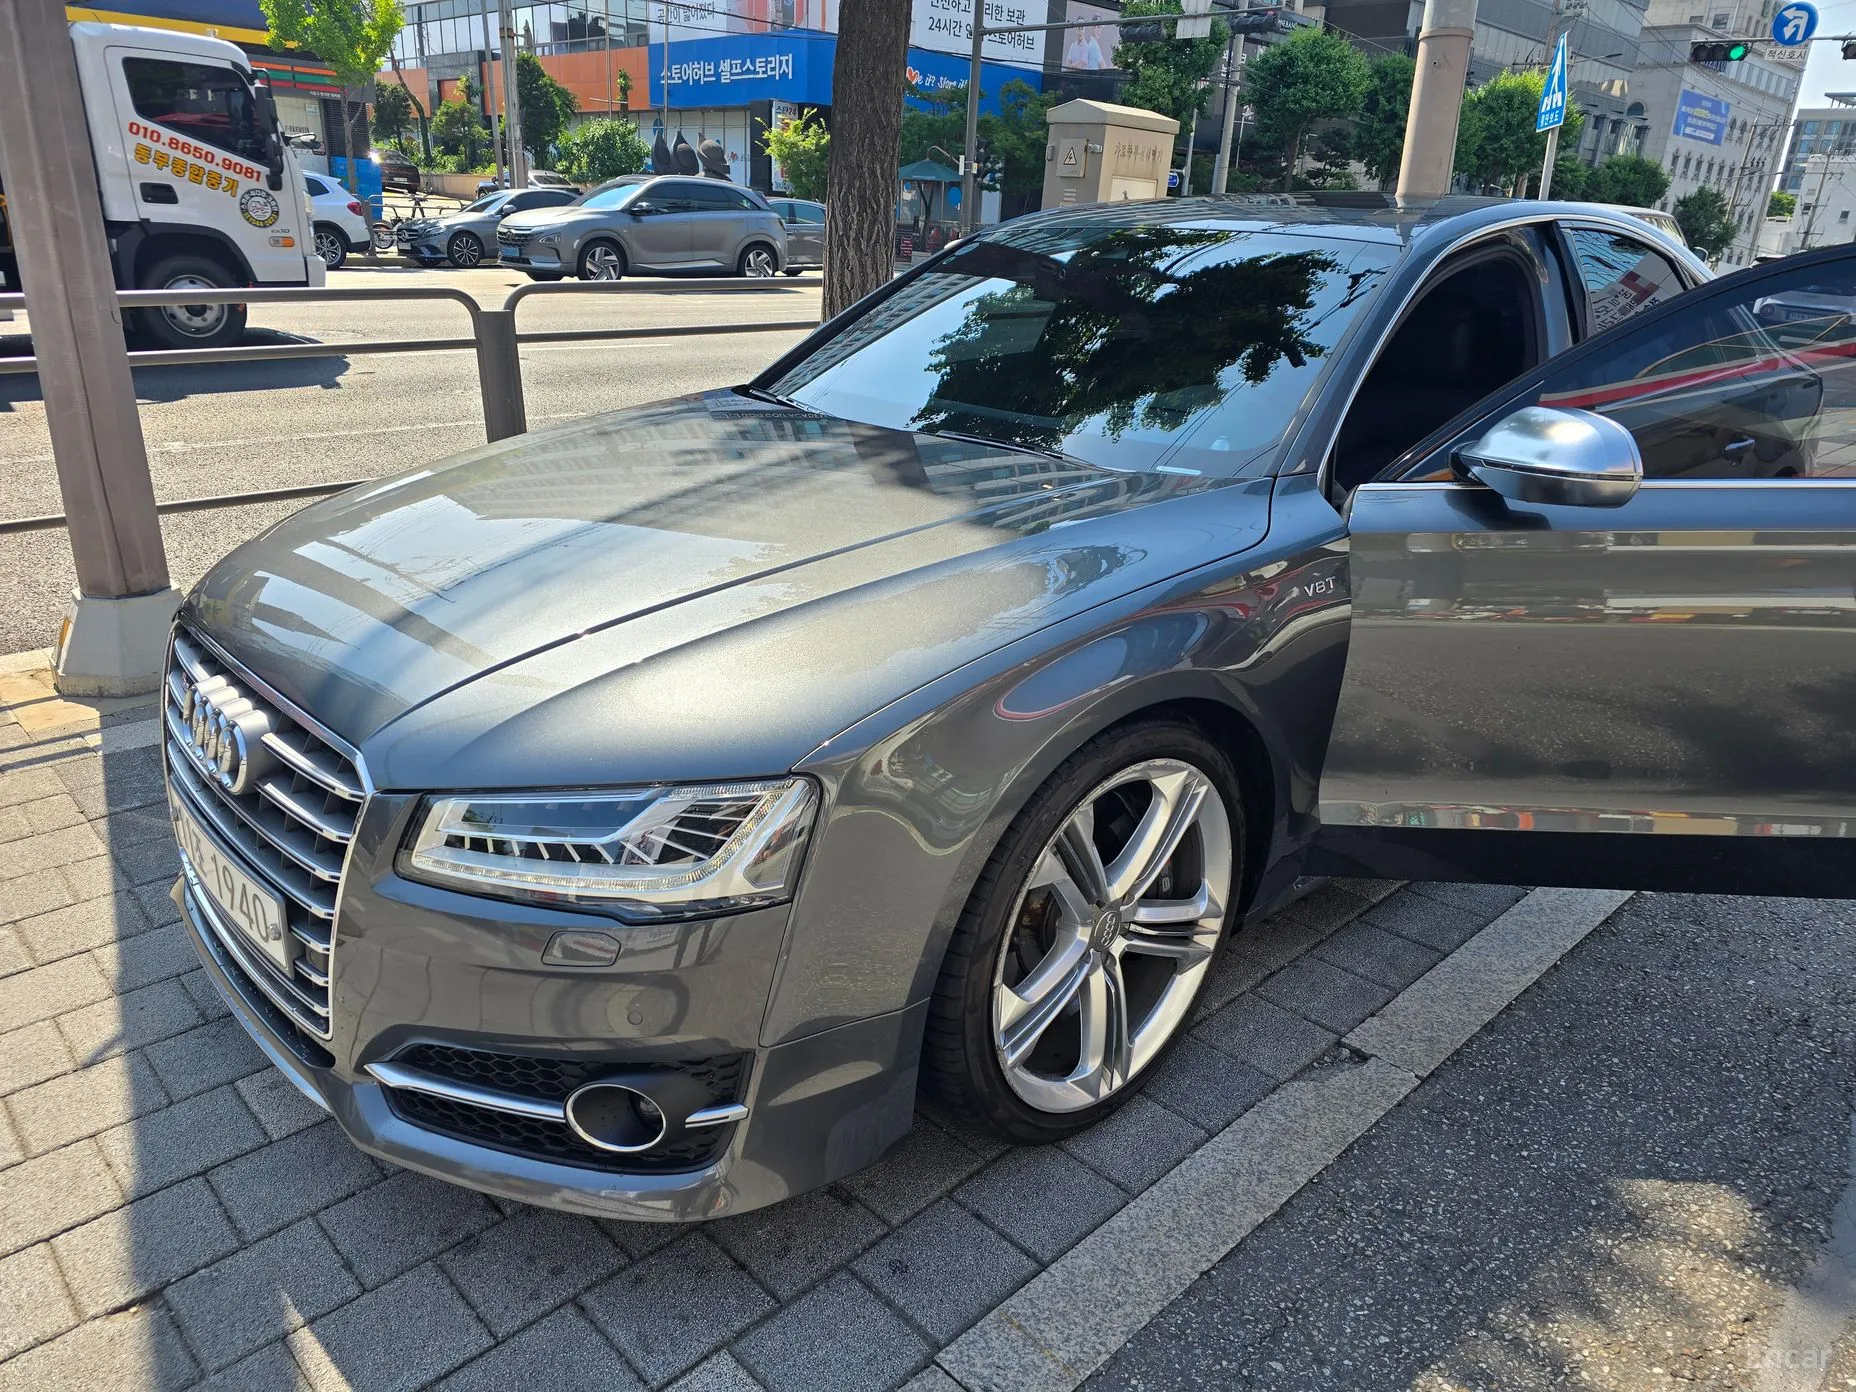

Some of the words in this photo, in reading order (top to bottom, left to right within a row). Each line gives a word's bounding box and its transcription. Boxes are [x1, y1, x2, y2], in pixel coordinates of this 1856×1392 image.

[928, 16, 963, 38] 24시간
[1006, 7, 1026, 26] 보관
[1766, 49, 1806, 61] 적신호시
[660, 60, 716, 86] 스토어허브
[718, 53, 793, 84] 셀프스토리지
[128, 121, 262, 182] 010.8650.9081
[134, 142, 240, 198] 동부종합중기
[1303, 575, 1336, 597] V8T
[210, 852, 270, 943] 1940
